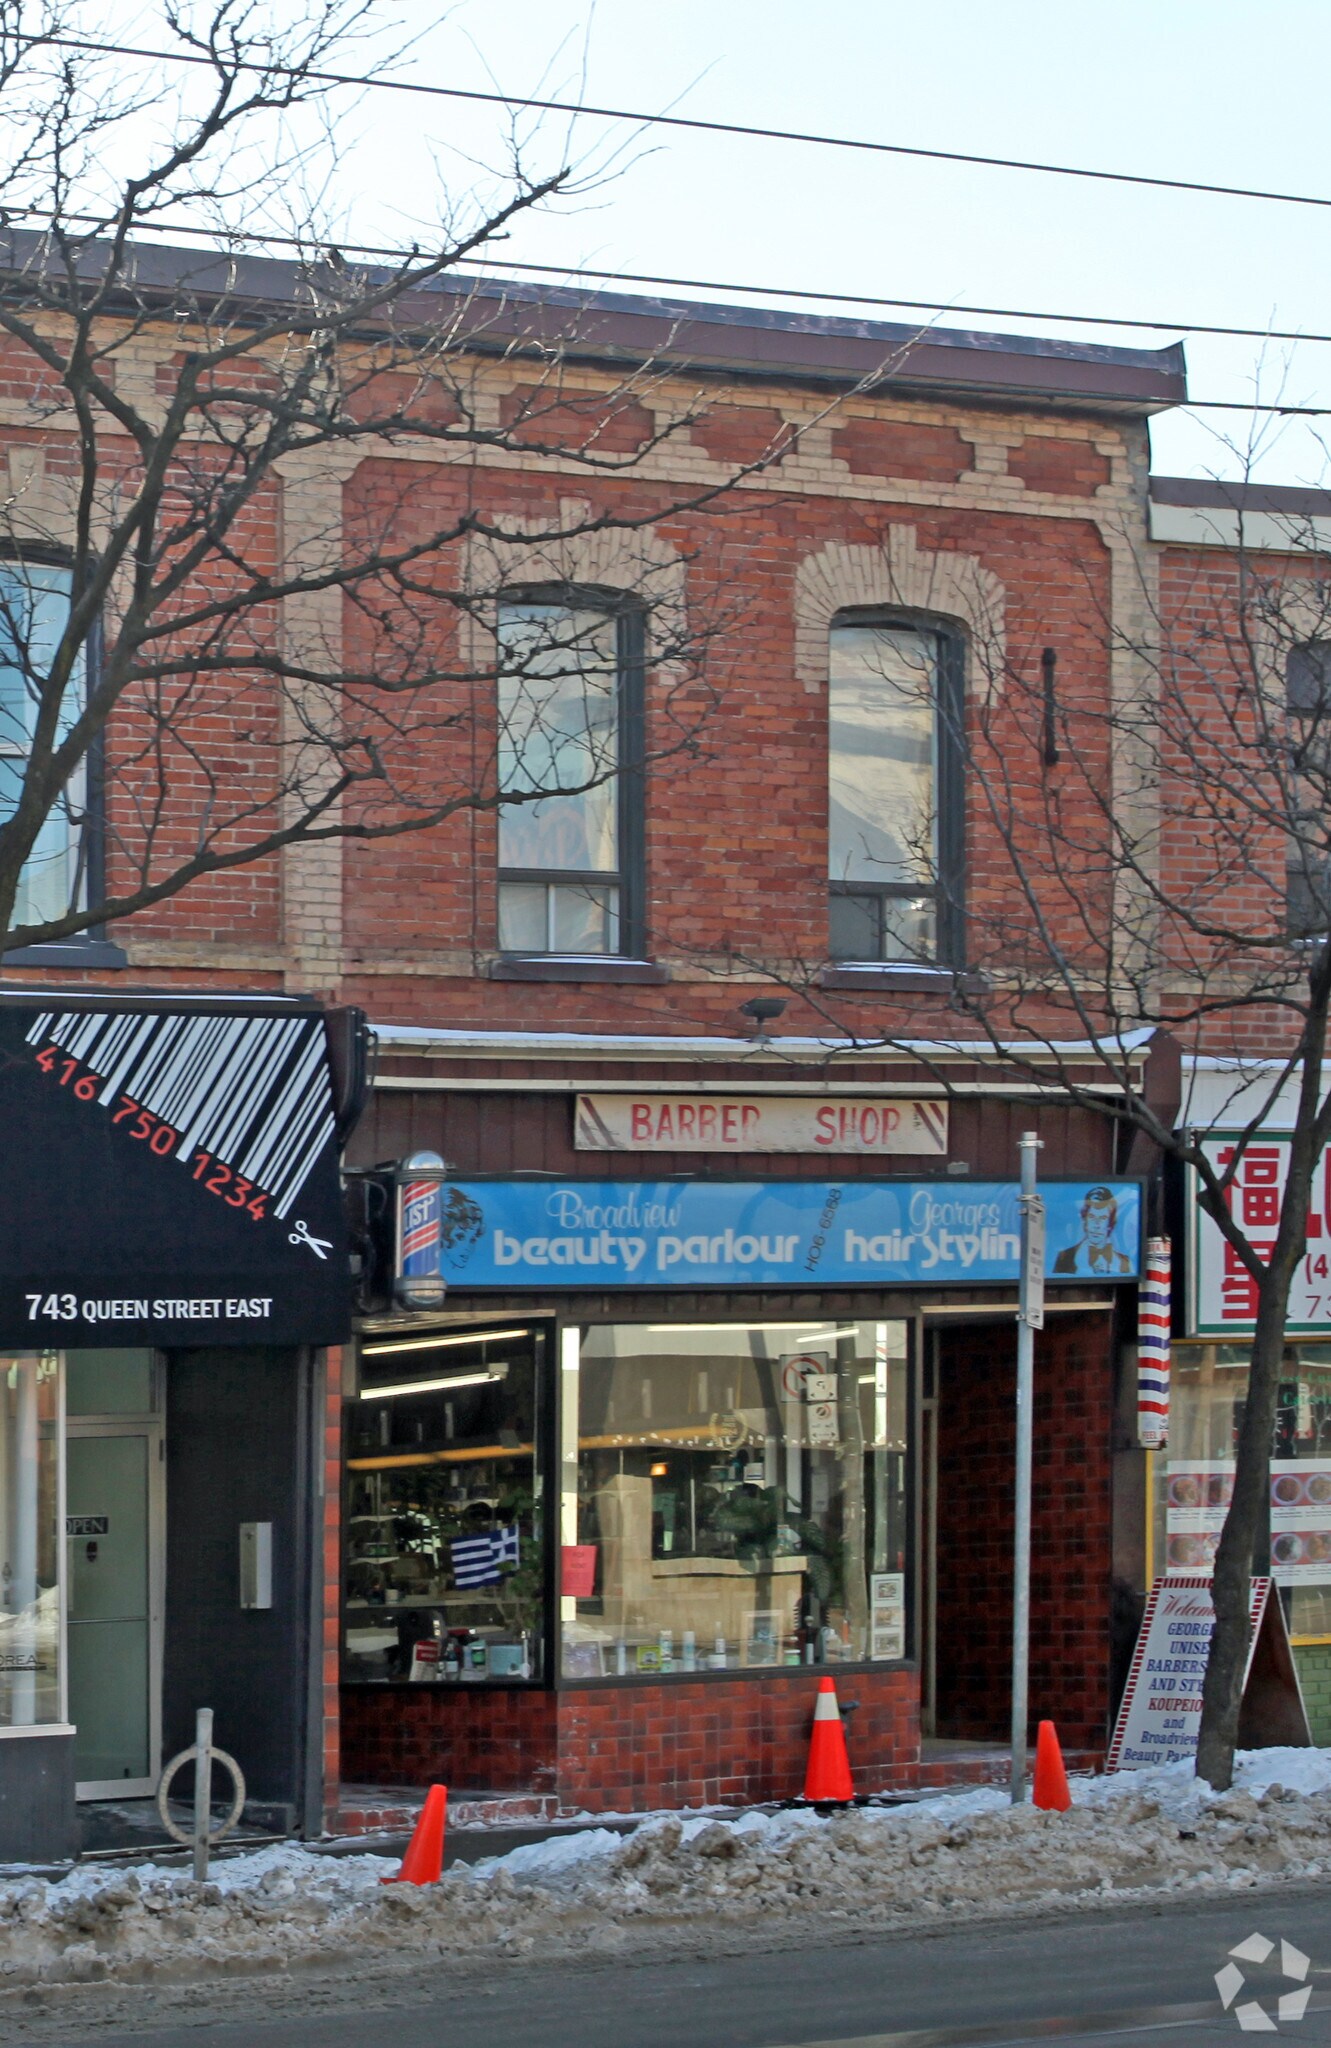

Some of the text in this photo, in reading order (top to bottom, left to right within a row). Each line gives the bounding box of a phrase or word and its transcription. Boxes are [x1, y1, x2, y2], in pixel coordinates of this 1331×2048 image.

[36, 1046, 268, 1221] 416 750 1234
[631, 1103, 761, 1144] BARBER
[814, 1105, 902, 1146] SHOP
[544, 1189, 681, 1229] Broadview
[909, 1190, 1000, 1237] Georges
[493, 1228, 800, 1271] beauty parlour
[844, 1228, 916, 1262] hair
[921, 1226, 1021, 1268] stylin
[25, 1293, 273, 1323] 743 QUEEN STREET EAST
[1161, 1594, 1216, 1617] Welcom
[1169, 1640, 1210, 1655] UNISE
[1146, 1658, 1208, 1674] BARBERS
[1148, 1677, 1176, 1691] AND
[1162, 1716, 1186, 1729] and
[1123, 1747, 1163, 1765] Beauty
